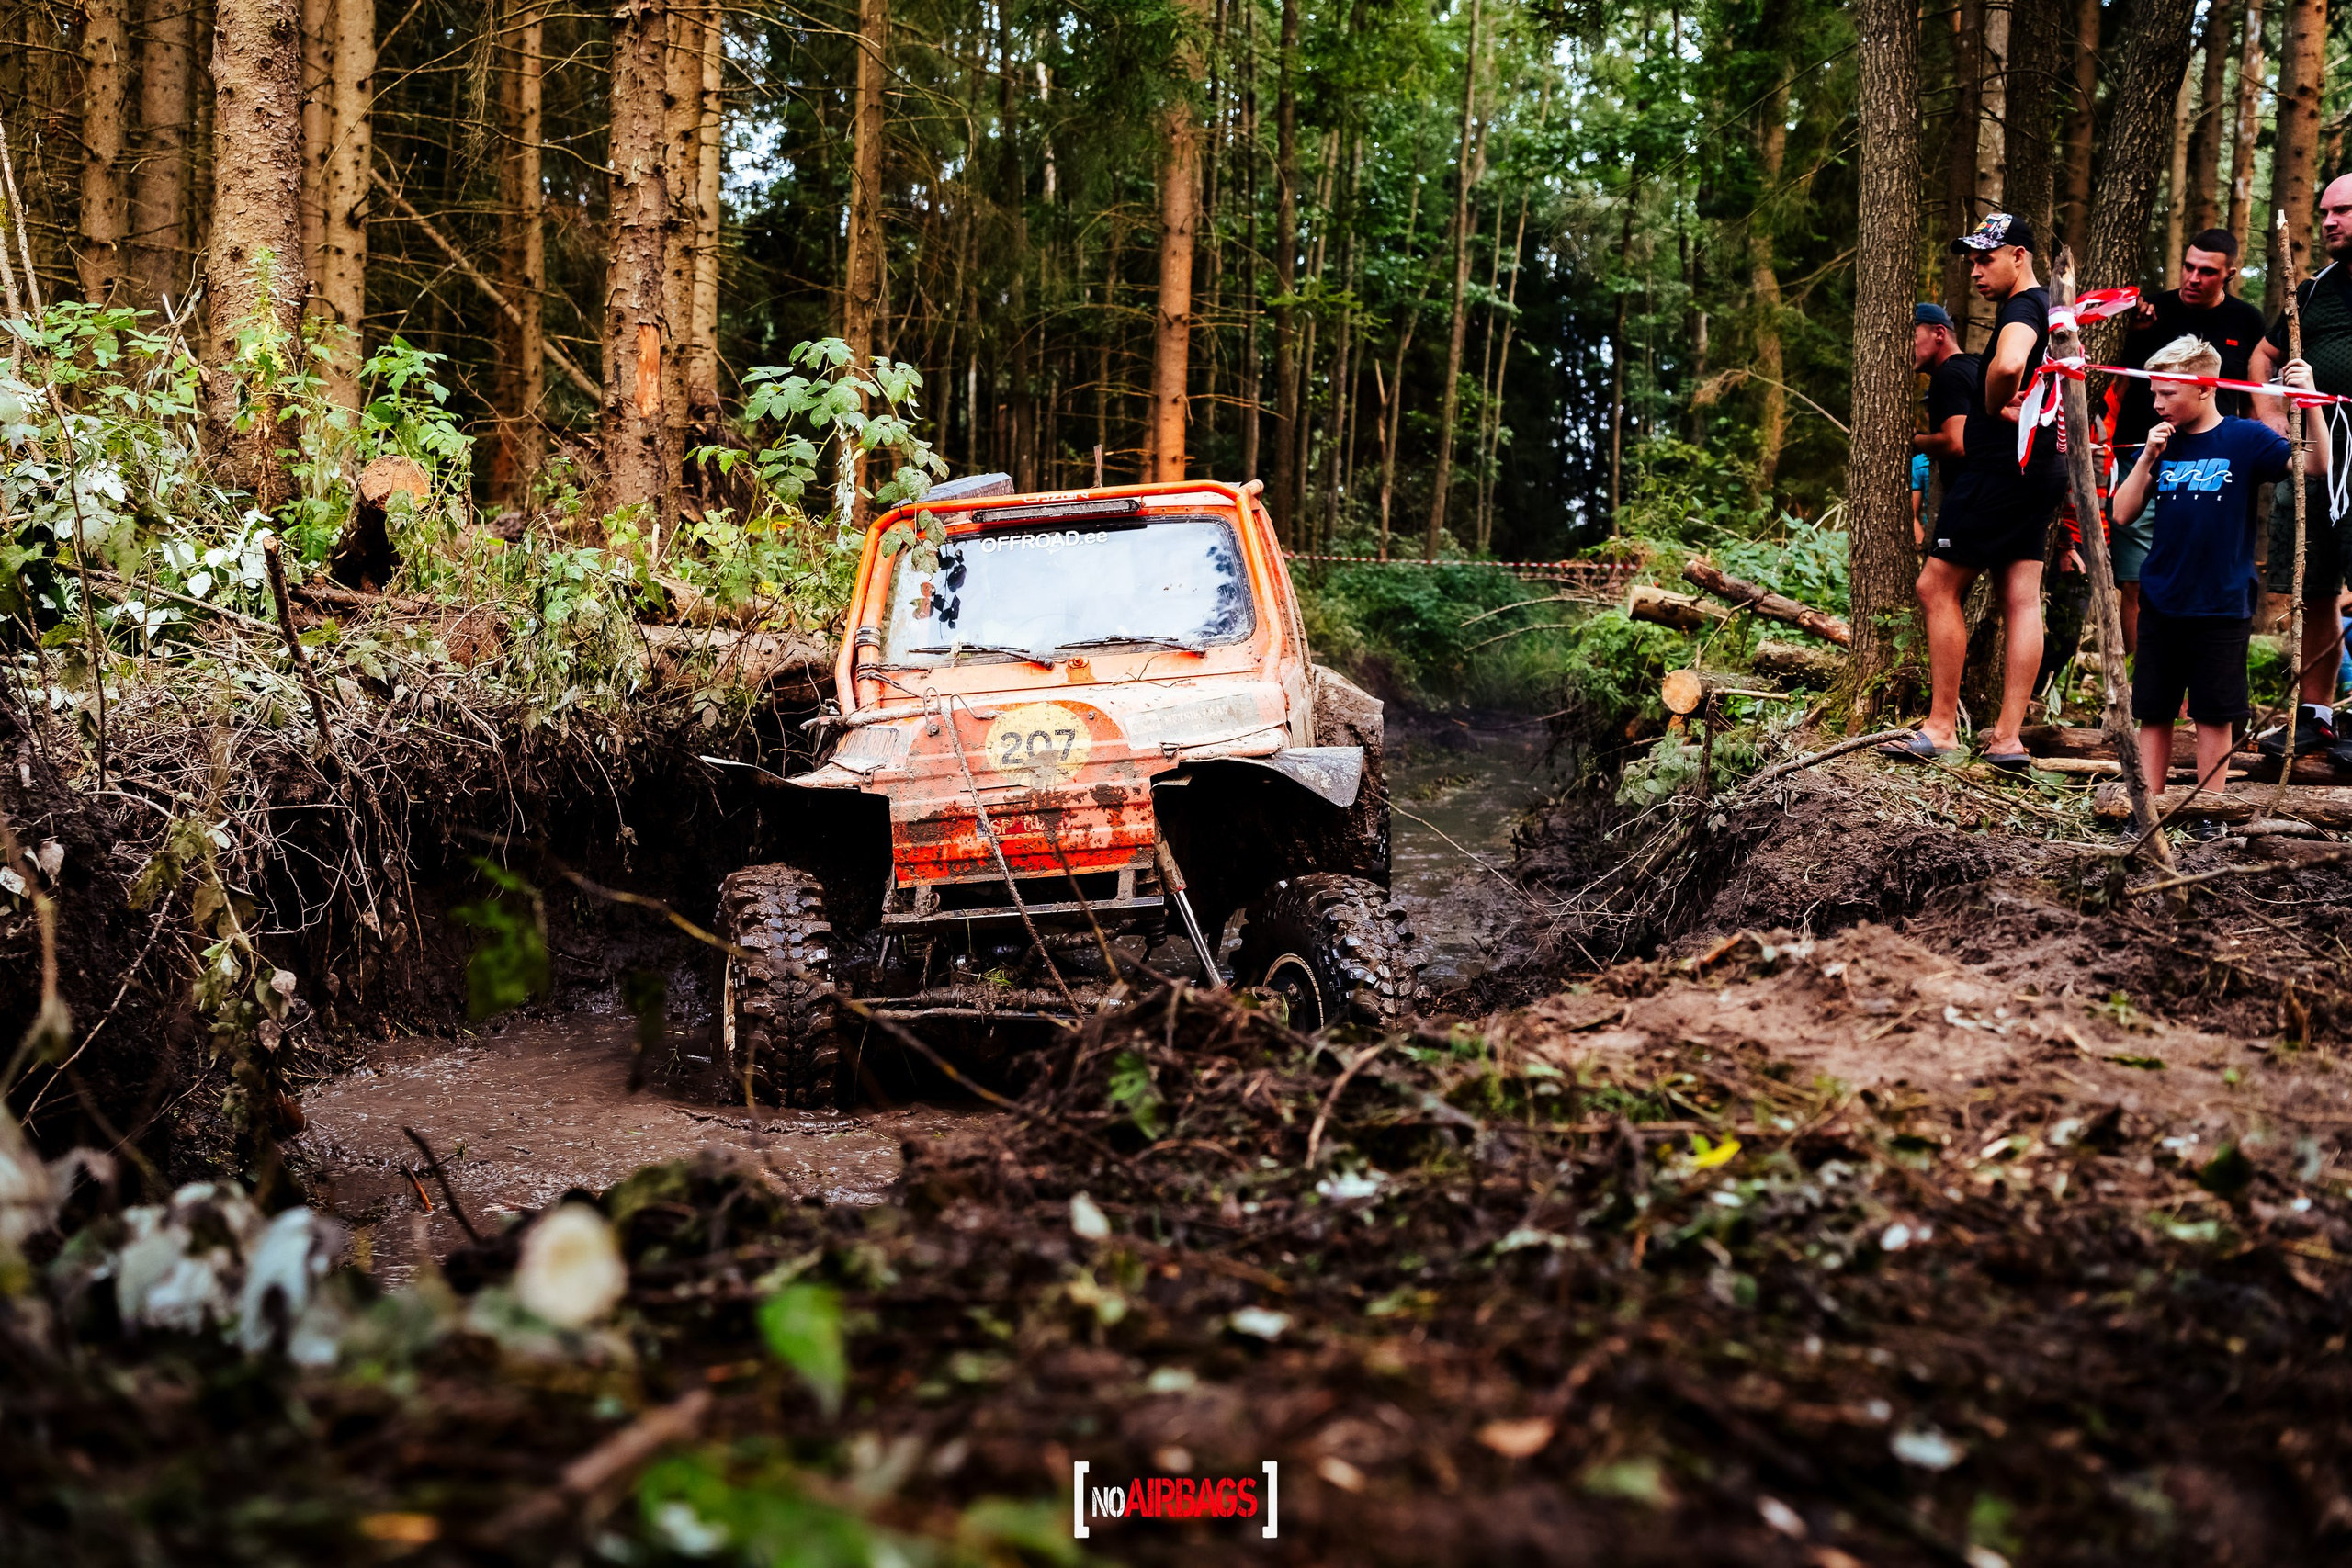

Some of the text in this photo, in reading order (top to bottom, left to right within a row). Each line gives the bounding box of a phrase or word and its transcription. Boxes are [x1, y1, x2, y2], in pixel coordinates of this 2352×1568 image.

[2158, 458, 2230, 491] EPIC
[980, 530, 1109, 553] OFFROAD.ee
[1000, 728, 1076, 764] 207
